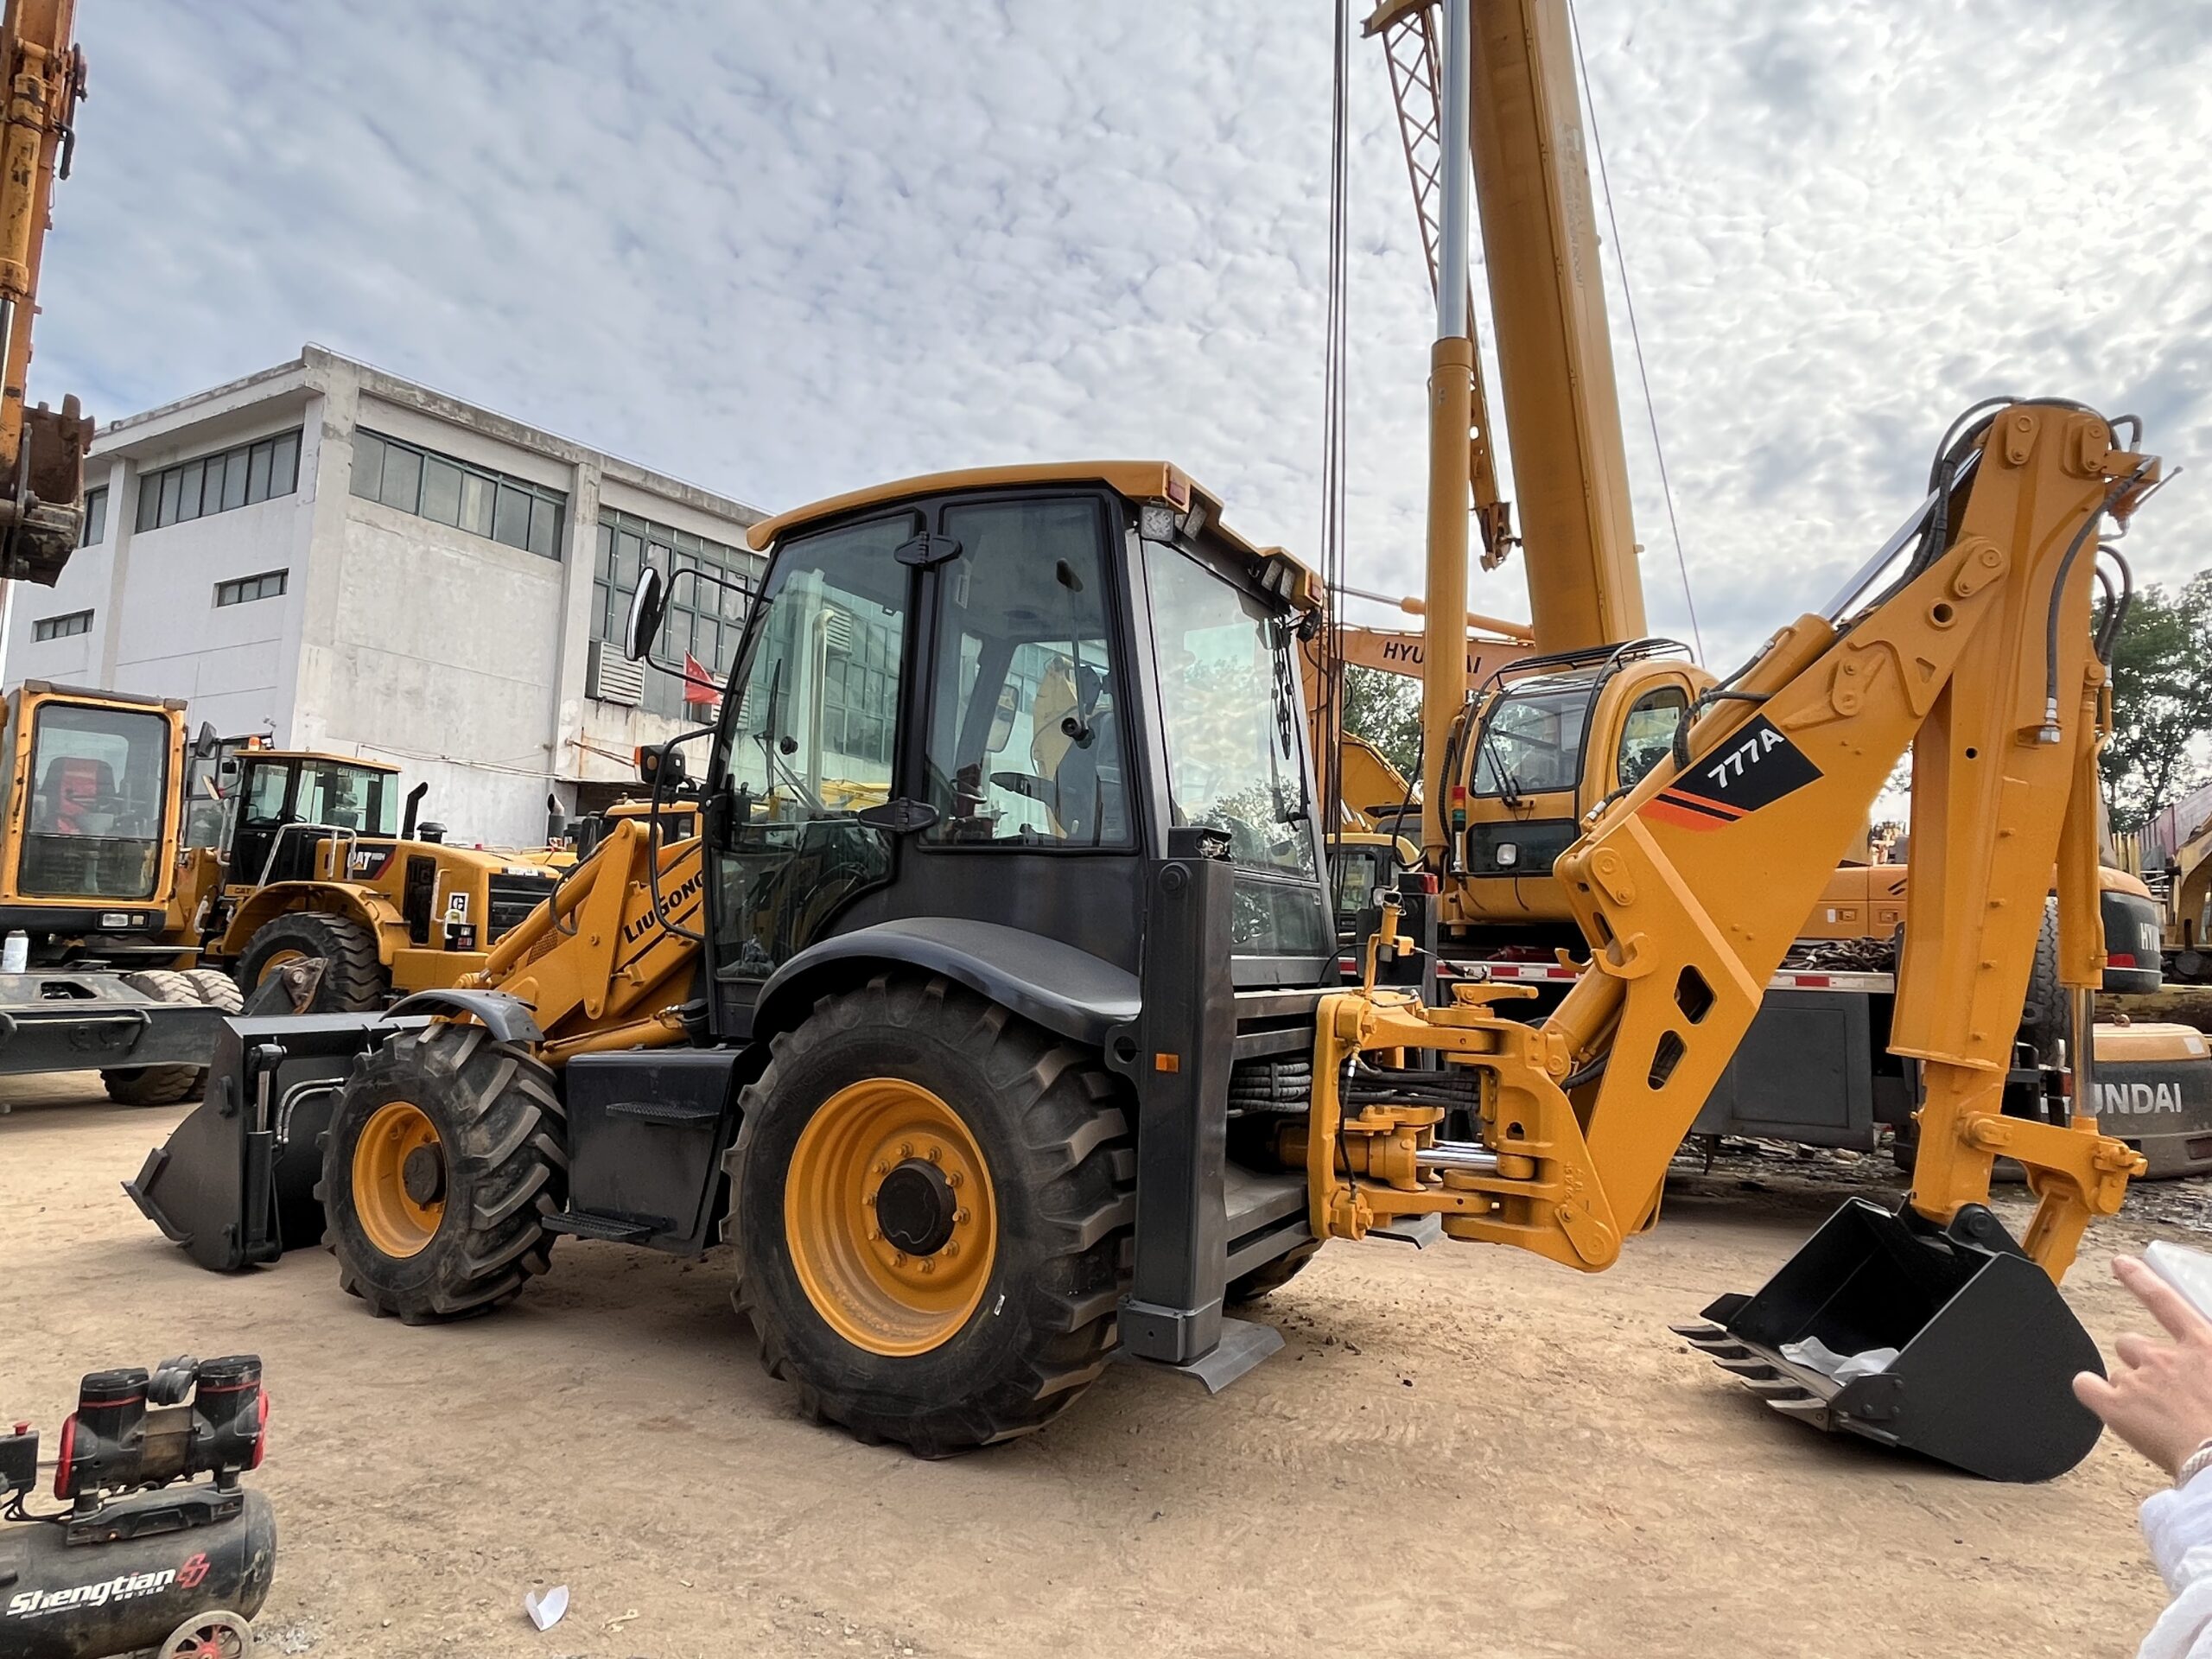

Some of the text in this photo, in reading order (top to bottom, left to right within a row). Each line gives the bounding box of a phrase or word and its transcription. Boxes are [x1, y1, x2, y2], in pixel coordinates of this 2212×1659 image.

[1383, 641, 1481, 674] HYUI
[1707, 728, 1785, 788] 777A
[6, 1568, 176, 1617] Shengtian
